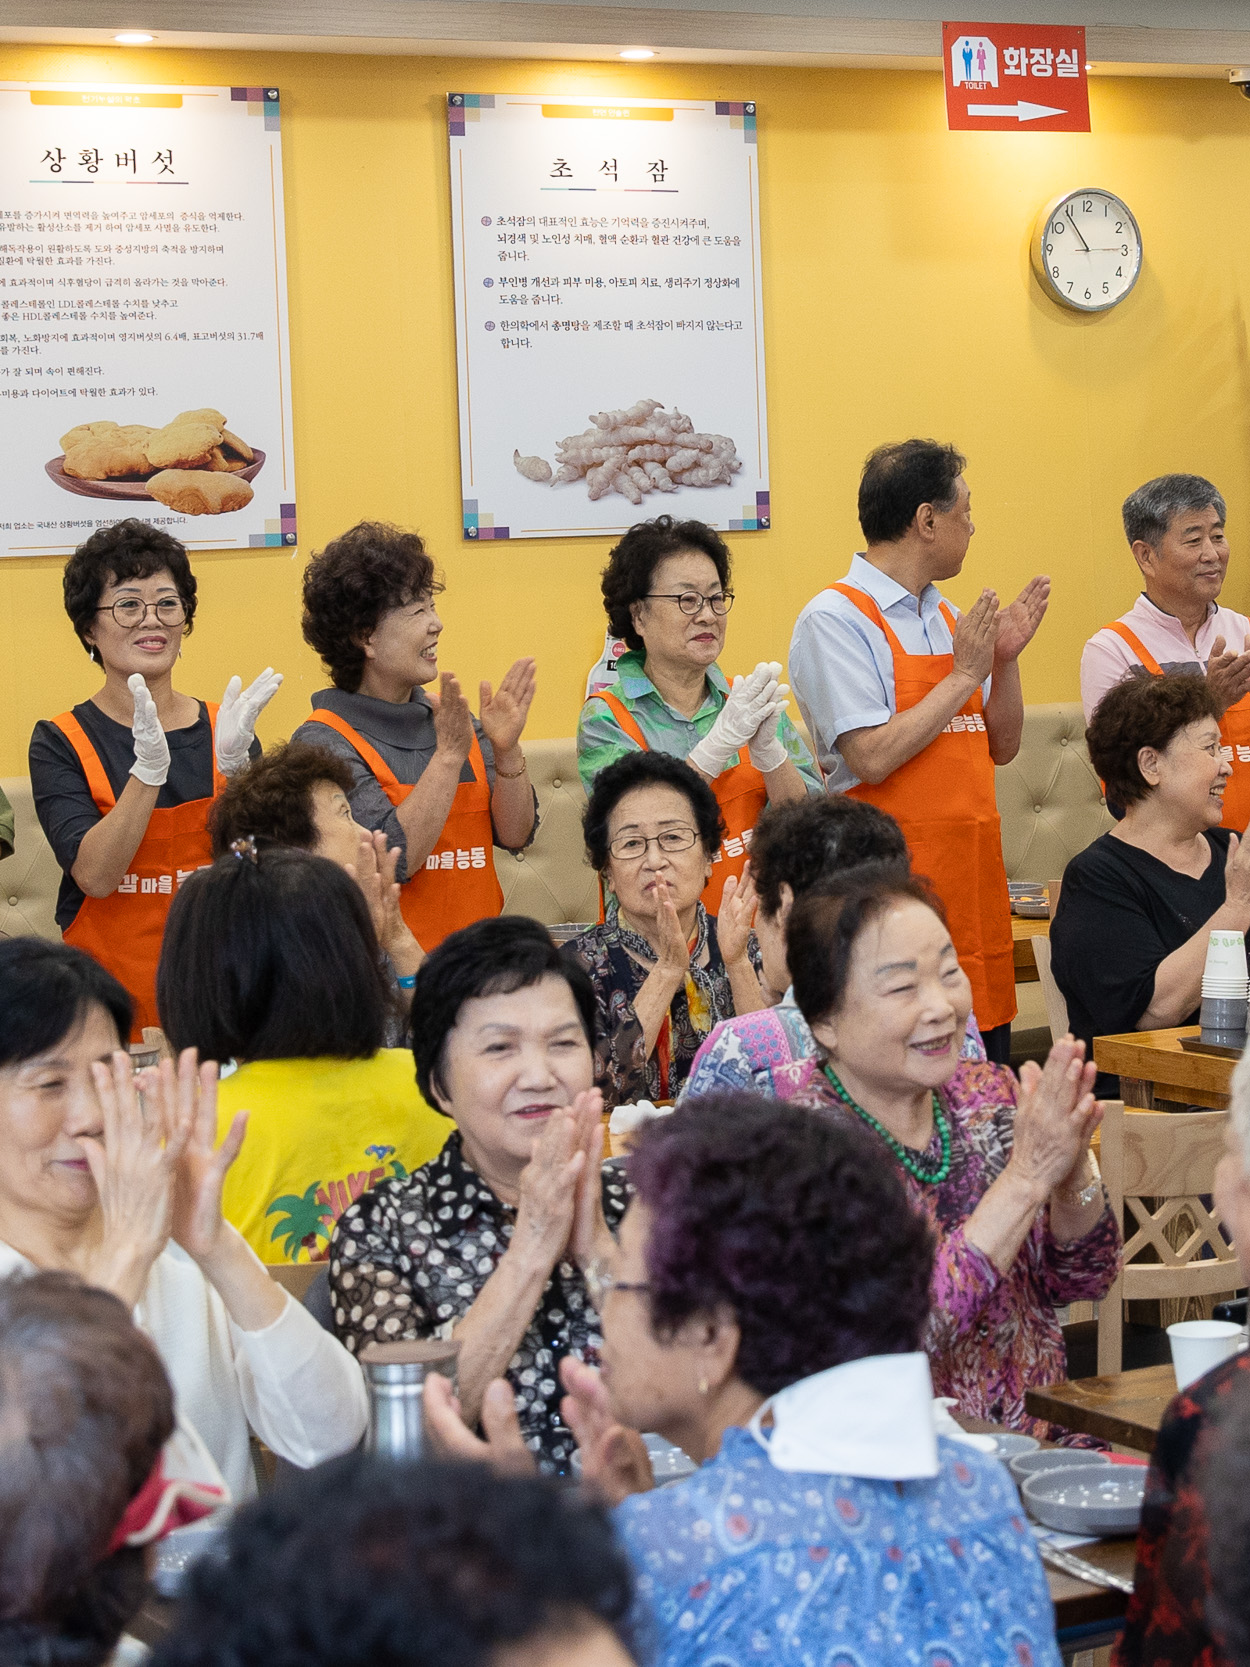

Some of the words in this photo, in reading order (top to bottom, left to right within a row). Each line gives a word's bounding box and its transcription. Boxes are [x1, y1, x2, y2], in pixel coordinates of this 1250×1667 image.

[1003, 46, 1079, 77] 화장실
[964, 81, 987, 90] TOILET
[40, 147, 175, 175] 상황버섯
[1083, 200, 1093, 212] 12
[0, 210, 21, 220] 포를
[497, 216, 535, 227] 초석잠의
[539, 216, 577, 227] 대표적인
[580, 217, 609, 228] 효능은
[611, 217, 649, 228] 기억력을
[1115, 222, 1123, 233] 2
[1051, 222, 1065, 234] 10
[497, 233, 527, 244] 뇌경색
[530, 233, 539, 244] 및
[542, 234, 571, 244] 노인성
[599, 234, 617, 244] 혈액
[620, 235, 648, 245] 순환과
[651, 235, 669, 245] 혈관
[672, 235, 700, 246] 건강에
[702, 236, 711, 246] 큰
[714, 236, 741, 246] 도움을
[497, 250, 530, 261] 줍니다.
[1046, 244, 1054, 256] 9
[1121, 244, 1129, 256] 3
[1052, 266, 1060, 278] 8
[1115, 266, 1122, 277] 4
[498, 277, 528, 288] 부인병
[531, 277, 560, 288] 개선과
[563, 277, 582, 288] 피부
[609, 277, 637, 288] 아토피
[664, 277, 701, 288] 생리주기
[704, 277, 740, 288] 정상화에
[1067, 282, 1074, 293] 7
[1102, 282, 1109, 294] 5
[1084, 288, 1092, 299] 6
[499, 294, 529, 305] 도움을
[531, 294, 563, 305] 줍니다.
[500, 320, 549, 331] 한의학에서
[593, 320, 620, 331] 제조할
[624, 320, 634, 330] 때
[636, 320, 673, 331] 초석잠이
[676, 320, 704, 330] 빠지지
[706, 320, 743, 331] 않는다고
[500, 338, 533, 349] 합니다.
